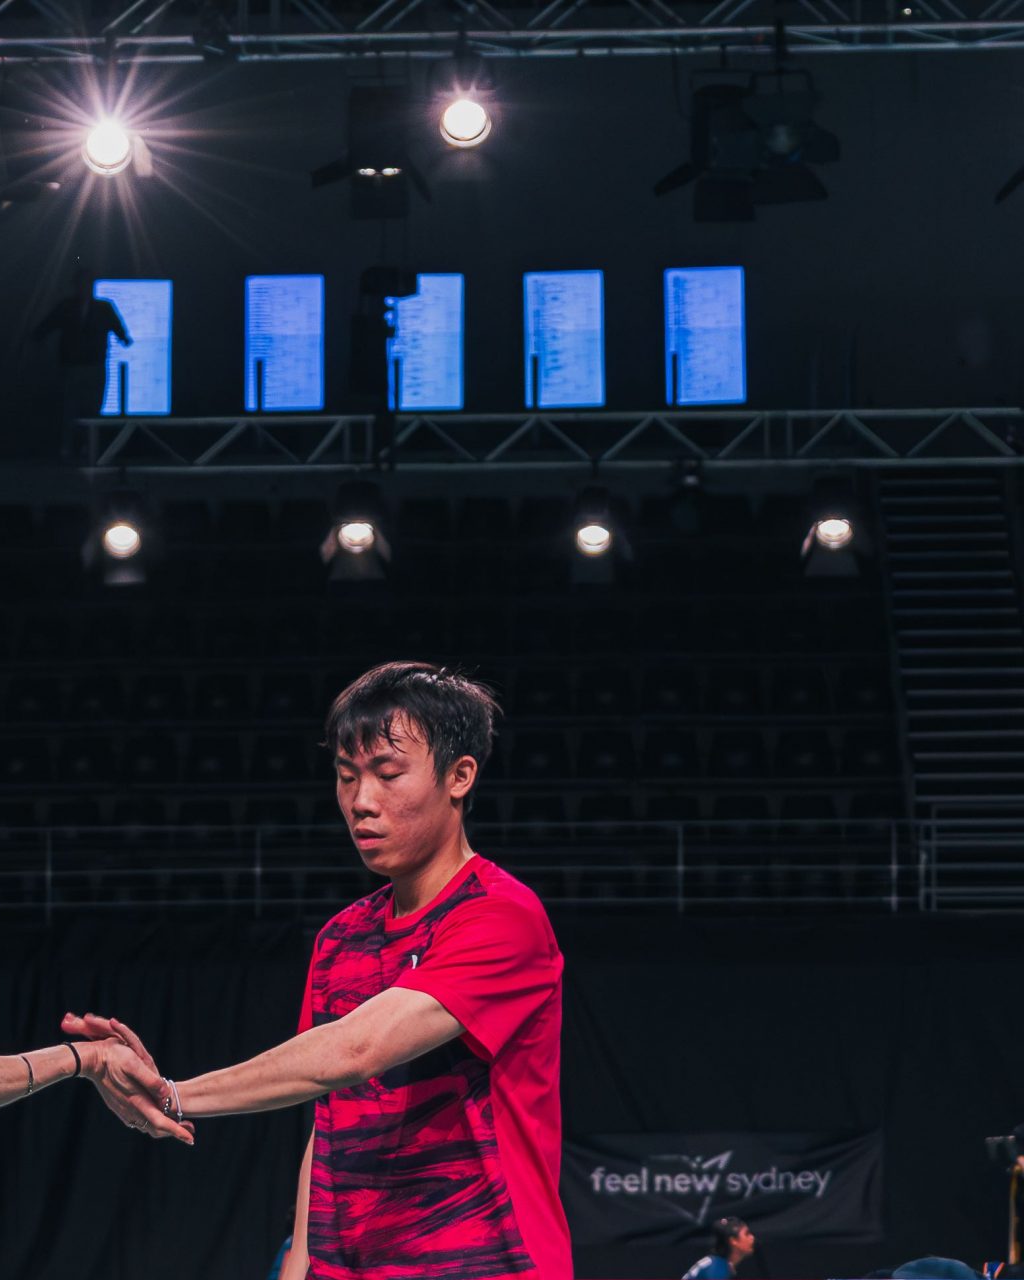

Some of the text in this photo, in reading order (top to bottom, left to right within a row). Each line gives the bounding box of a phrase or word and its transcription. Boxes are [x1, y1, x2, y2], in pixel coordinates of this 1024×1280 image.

[590, 1166, 831, 1197] feel new sydney
